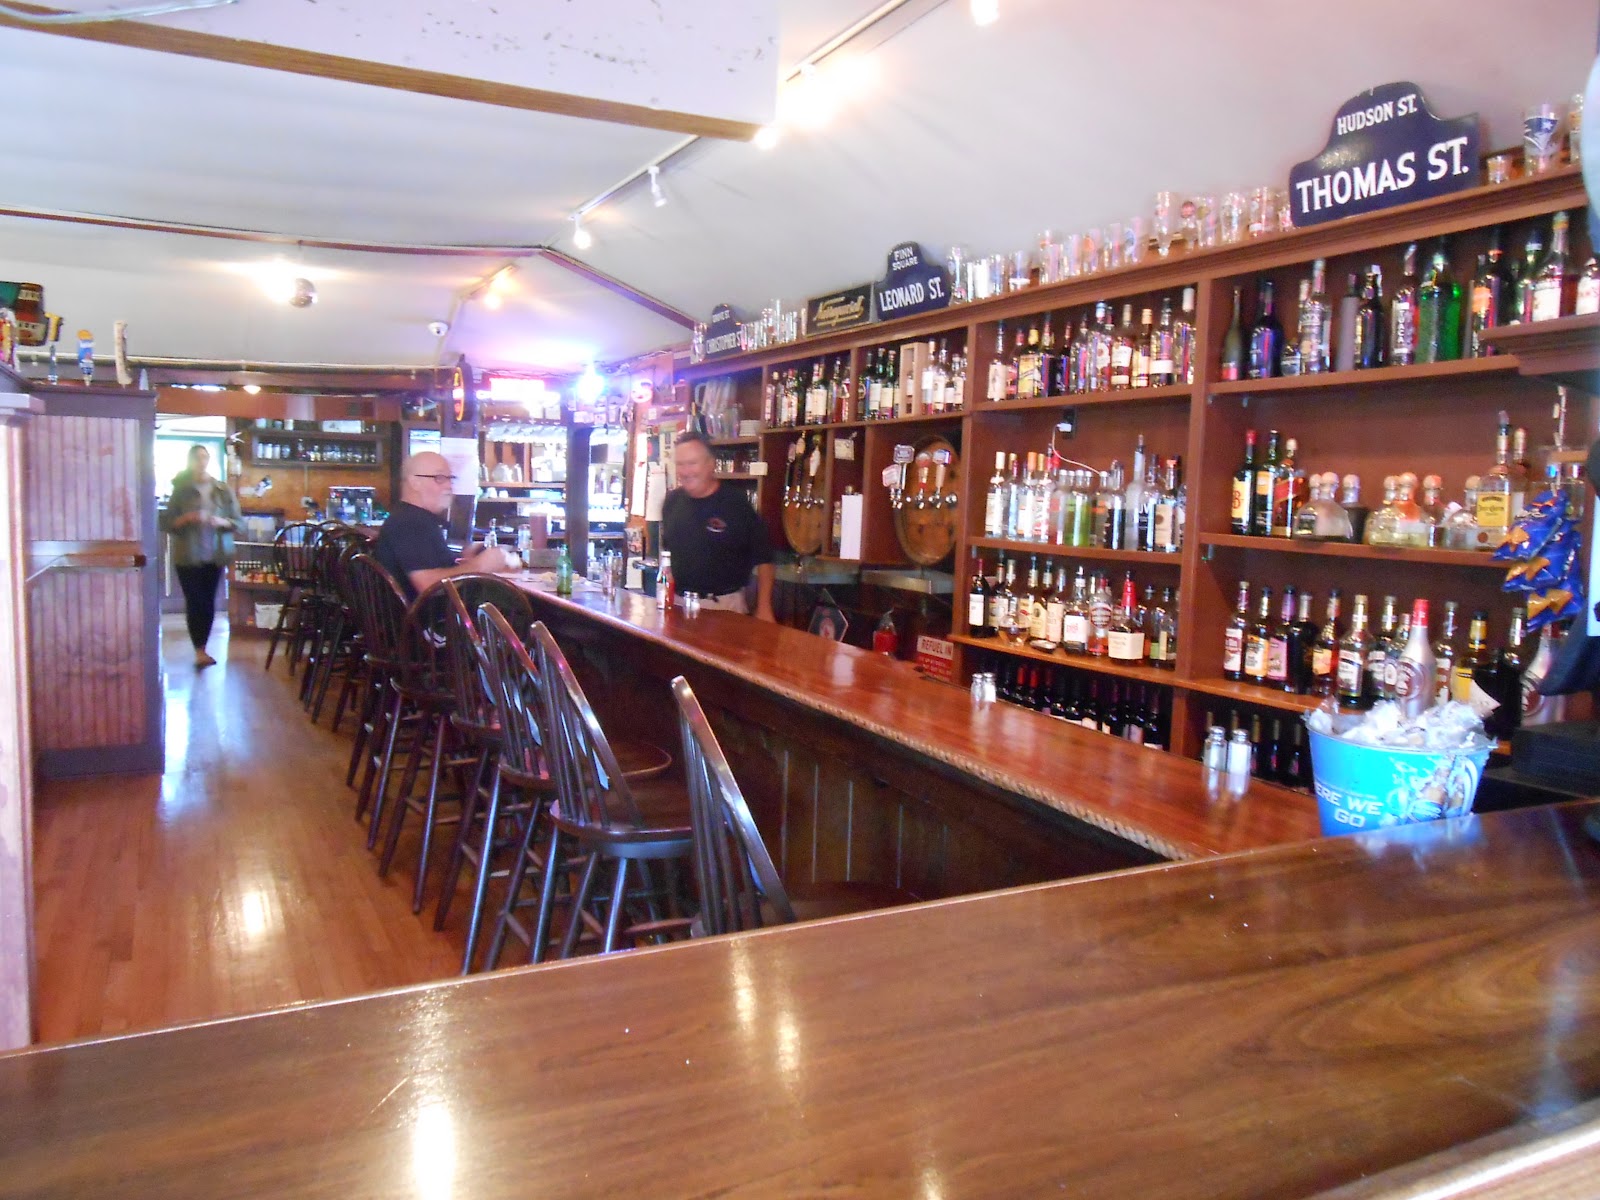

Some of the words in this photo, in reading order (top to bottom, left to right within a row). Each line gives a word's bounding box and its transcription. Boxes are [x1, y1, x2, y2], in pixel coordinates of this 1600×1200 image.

[1338, 102, 1394, 136] HUDSON
[1397, 94, 1418, 117] ST.
[1296, 151, 1416, 214] THOMAS
[1427, 137, 1470, 181] ST.
[892, 256, 919, 271] SQUARE
[894, 247, 914, 261] FINN
[879, 282, 925, 312] LEONARD
[928, 276, 945, 300] ST.
[921, 638, 944, 655] REFUEL
[1315, 785, 1342, 806] ERE
[1347, 797, 1384, 816] WE
[1334, 807, 1367, 828] GO
